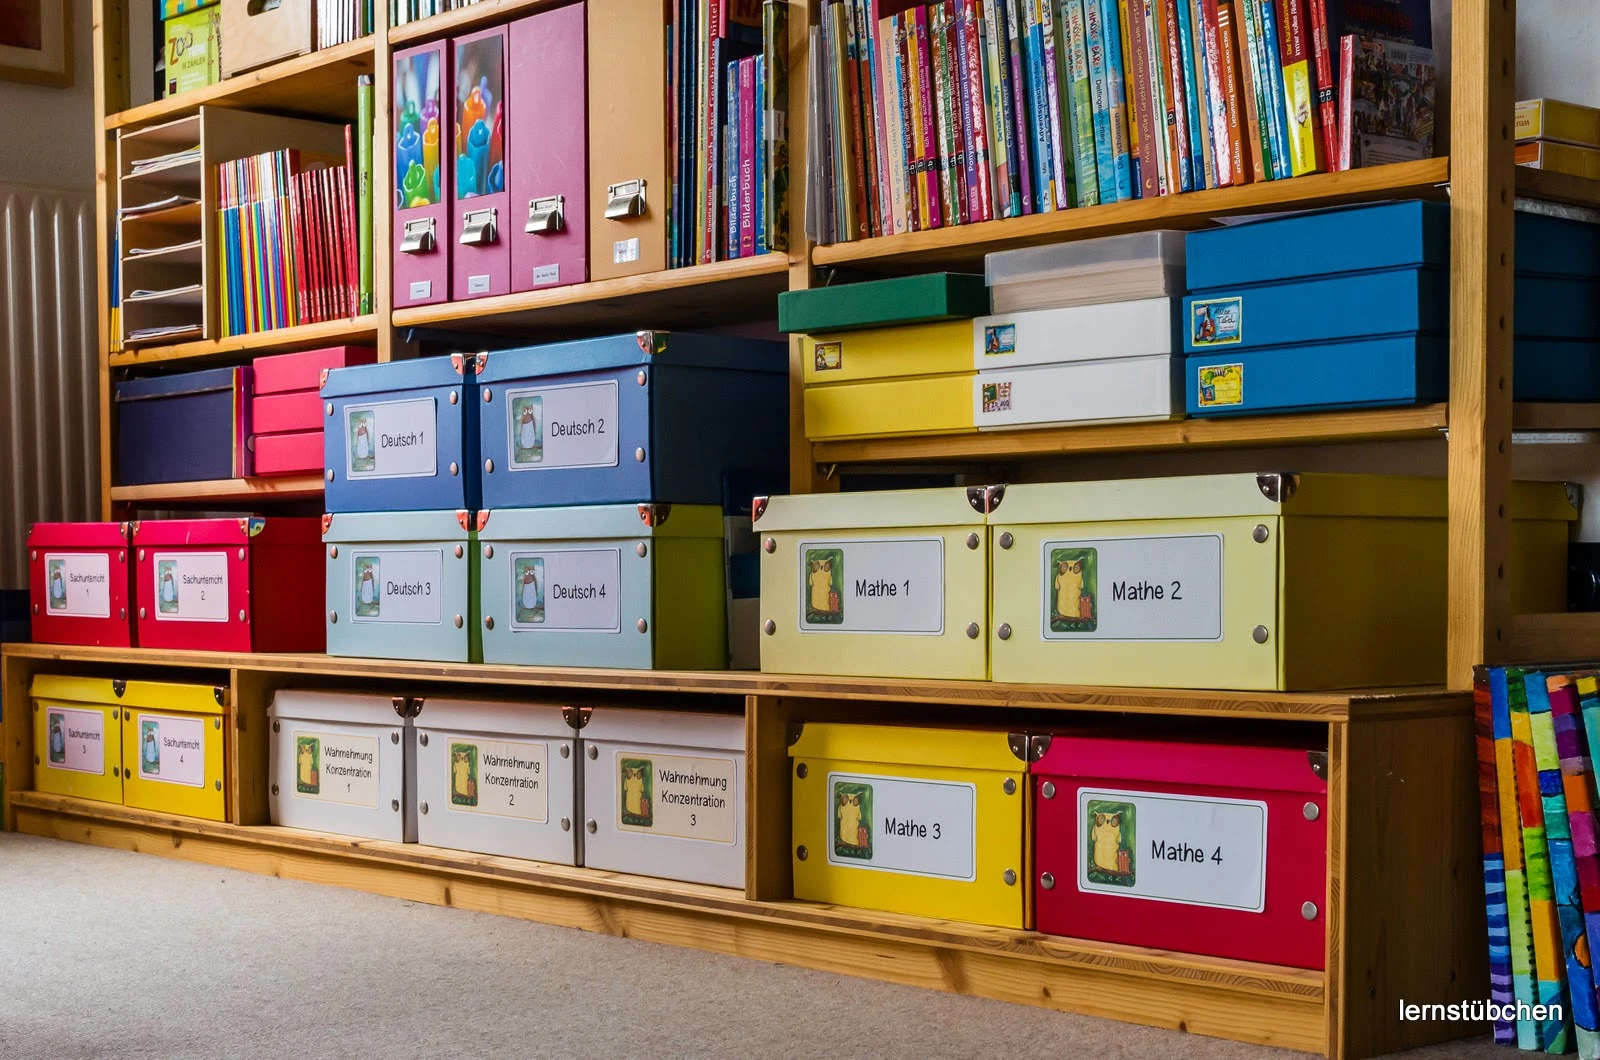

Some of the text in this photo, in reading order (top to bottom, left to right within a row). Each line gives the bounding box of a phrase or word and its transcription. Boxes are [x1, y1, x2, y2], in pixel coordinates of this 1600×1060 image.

[710, 3, 718, 37] bitte!
[947, 41, 952, 51] du
[1106, 11, 1115, 61] Geschichten
[1291, 15, 1300, 56] immer volles
[885, 37, 893, 78] Lesenlernen
[940, 45, 945, 55] du
[958, 29, 966, 80] Lesenlernen
[1135, 43, 1146, 111] Geschichtenbuch
[1004, 106, 1010, 115] K.
[1034, 61, 1045, 142] Adventsgeschichten
[1095, 79, 1106, 143] Delfingeschichten
[1229, 94, 1237, 128] Geburtstag
[889, 97, 898, 158] Geschichtenbuch
[964, 100, 975, 172] Ponygeschichten
[1114, 112, 1122, 153] schönsten
[1141, 114, 1150, 141] großes
[742, 159, 751, 228] Bilderbuch
[729, 175, 738, 234] Bilderbuch
[551, 418, 606, 438] Deutsch 2
[381, 430, 424, 448] Deutsch 1
[69, 572, 106, 584] Sachunterricht
[182, 574, 223, 586] Sachunterricht
[386, 580, 431, 596] Deutsch 3
[855, 578, 910, 598] Mathe 1
[201, 590, 206, 601] 2
[552, 582, 607, 600] Deutsch 4
[1112, 580, 1183, 602] Mathe 2
[68, 728, 101, 741] Sachunterricht
[163, 736, 201, 751] Sachunterricht
[82, 744, 87, 754] 3
[179, 754, 185, 765] 4
[324, 746, 374, 765] Wahrnehmung
[325, 763, 373, 779] Konzentration
[482, 753, 540, 774] Wahrnehmung
[484, 772, 539, 790] Konzentration
[658, 768, 728, 792] Wahrnehmung
[508, 793, 515, 806] 2
[661, 789, 726, 810] Konzentration
[690, 813, 697, 827] 3
[885, 816, 942, 840] Mathe 3
[1151, 839, 1224, 866] Mathe 4
